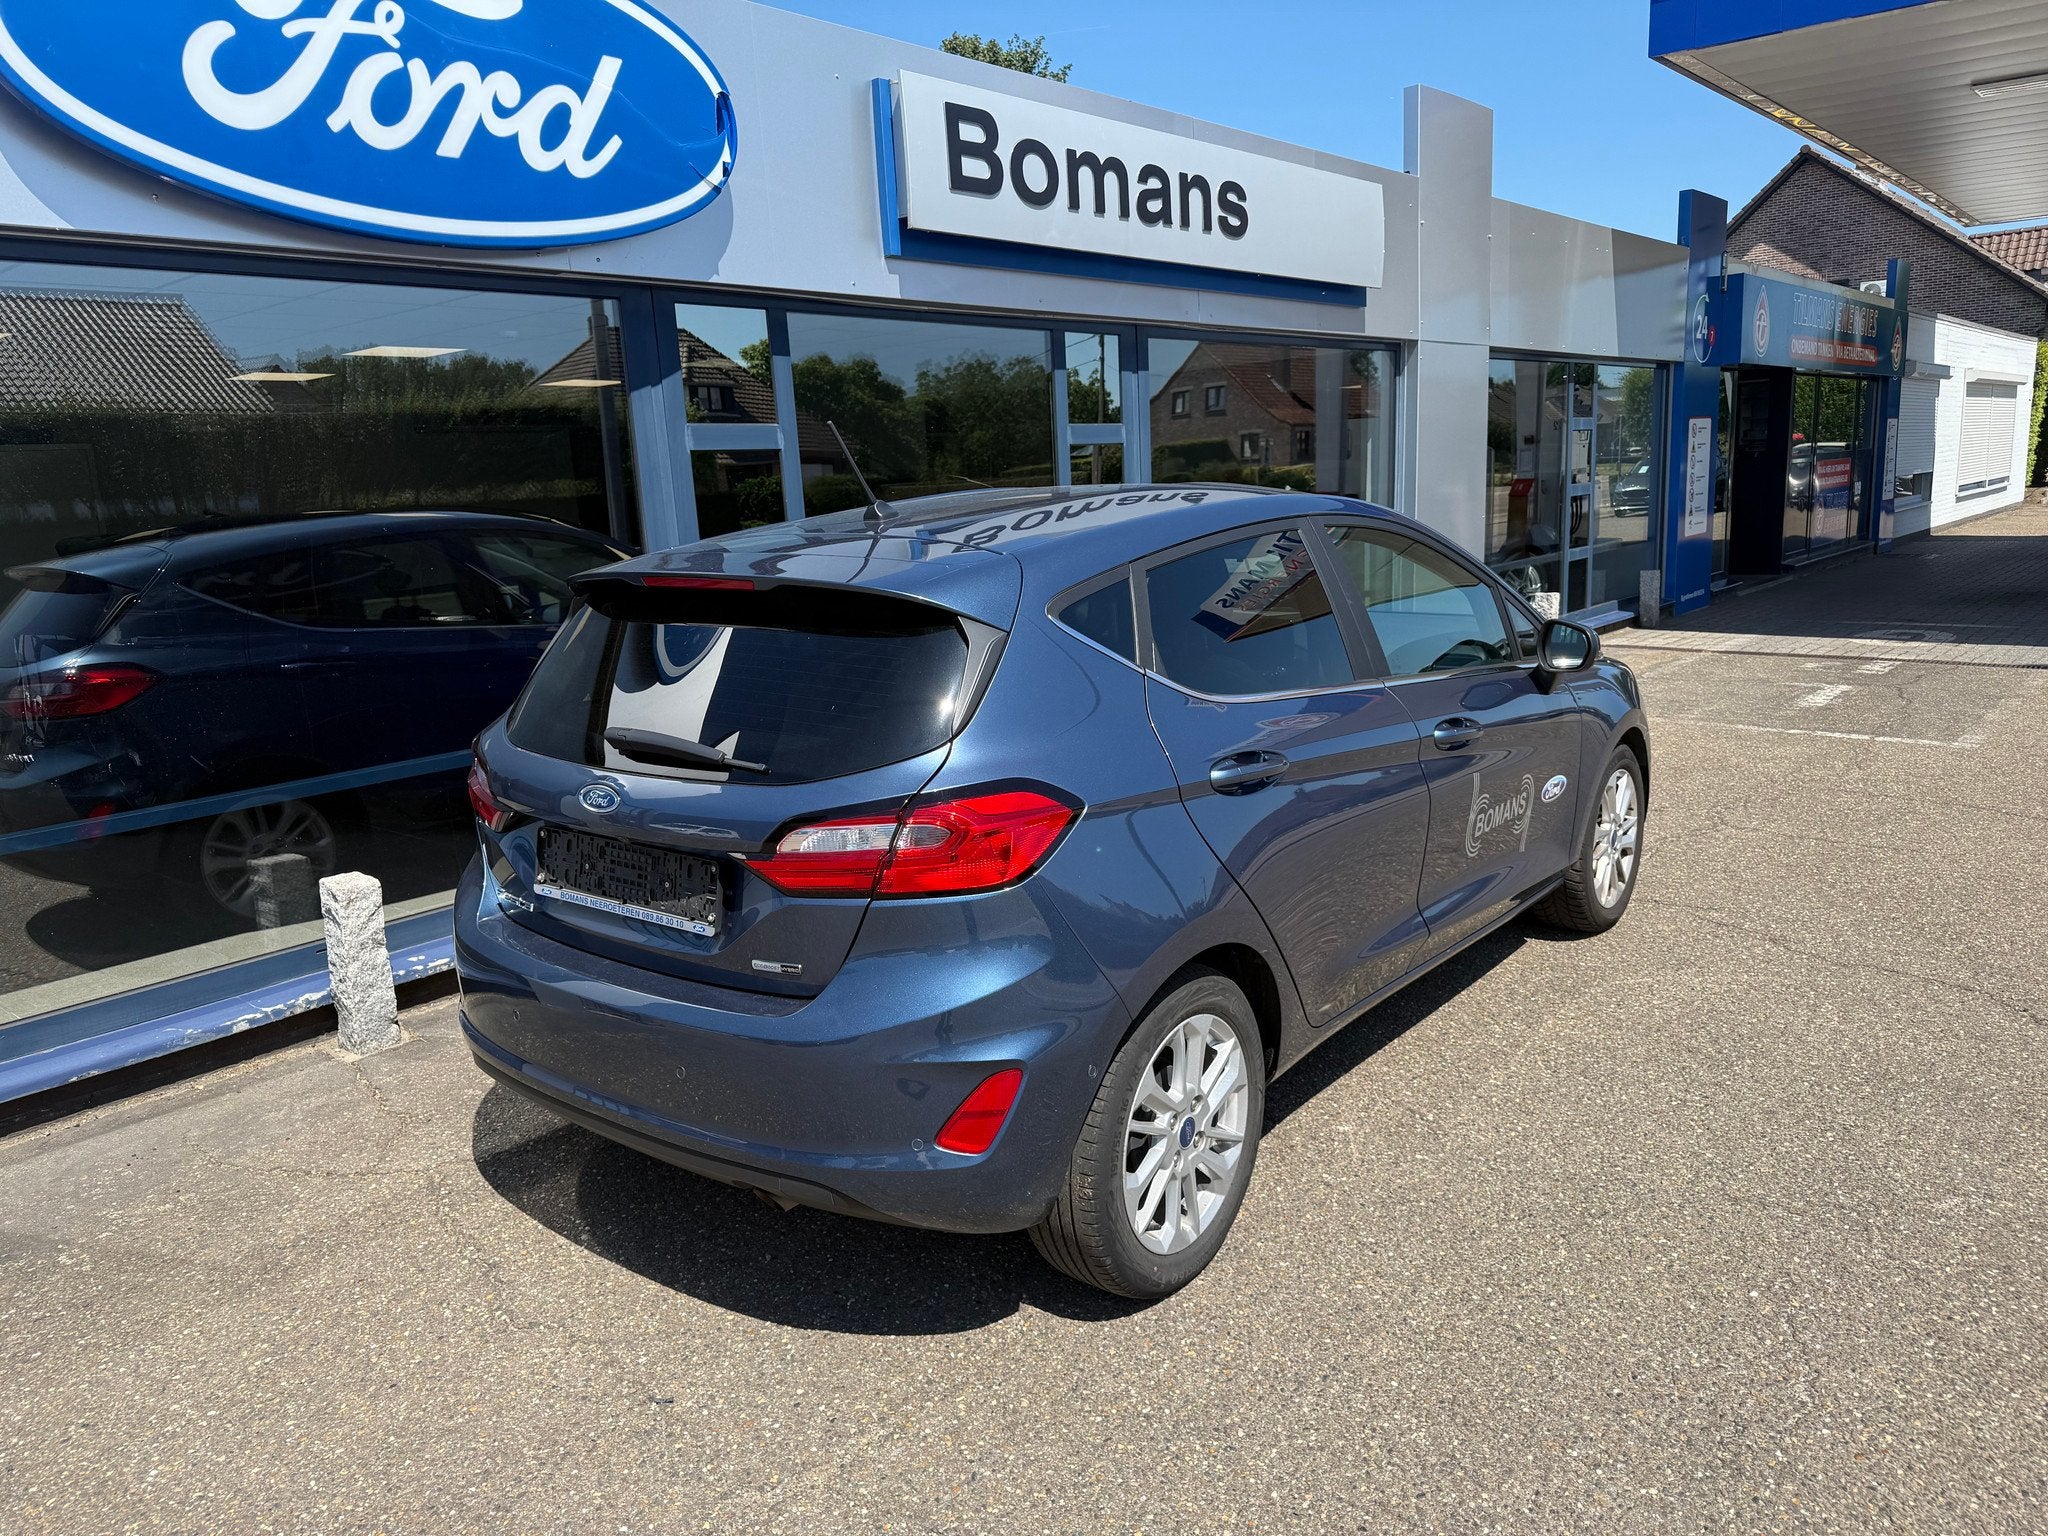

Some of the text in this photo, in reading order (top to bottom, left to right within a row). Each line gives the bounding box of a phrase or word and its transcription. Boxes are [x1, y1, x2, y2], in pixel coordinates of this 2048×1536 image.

[182, 0, 624, 179] Ford
[944, 101, 1249, 239] Bomans
[1696, 314, 1708, 340] 24
[1474, 791, 1527, 838] BOMANS
[560, 891, 589, 906] BOMANS
[590, 898, 641, 918] NEEROETEREN
[665, 917, 674, 927] 30
[676, 919, 684, 928] 10
